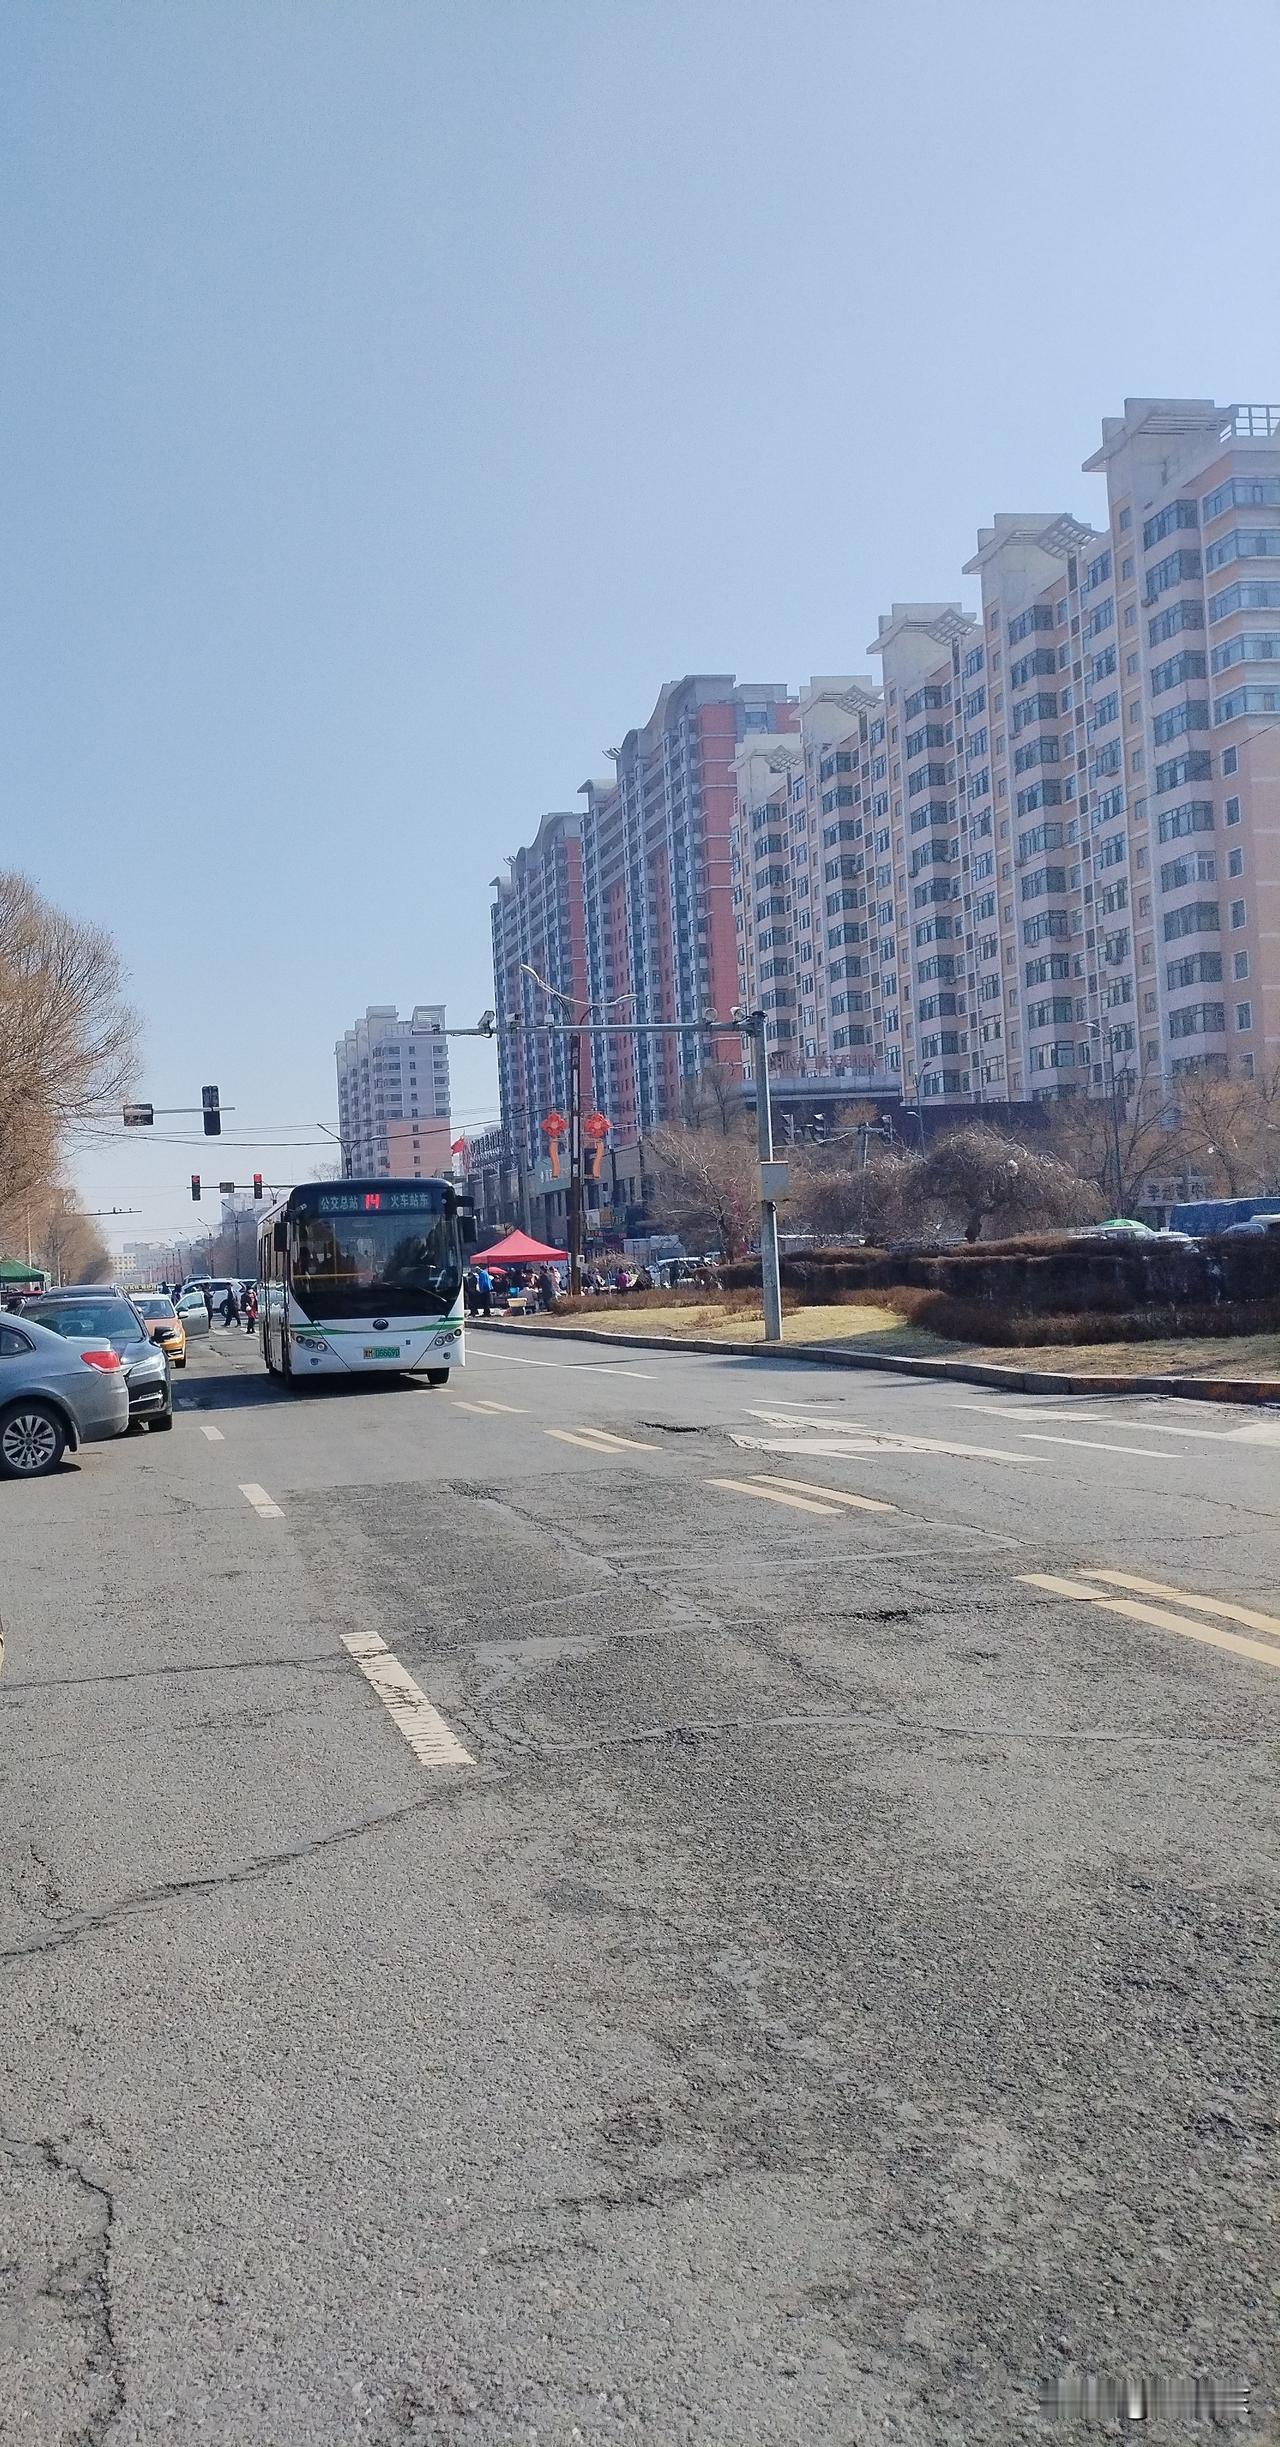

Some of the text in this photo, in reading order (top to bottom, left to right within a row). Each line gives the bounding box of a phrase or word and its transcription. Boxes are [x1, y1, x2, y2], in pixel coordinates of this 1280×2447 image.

[321, 1192, 428, 1210] 公交总站 14 火车站东
